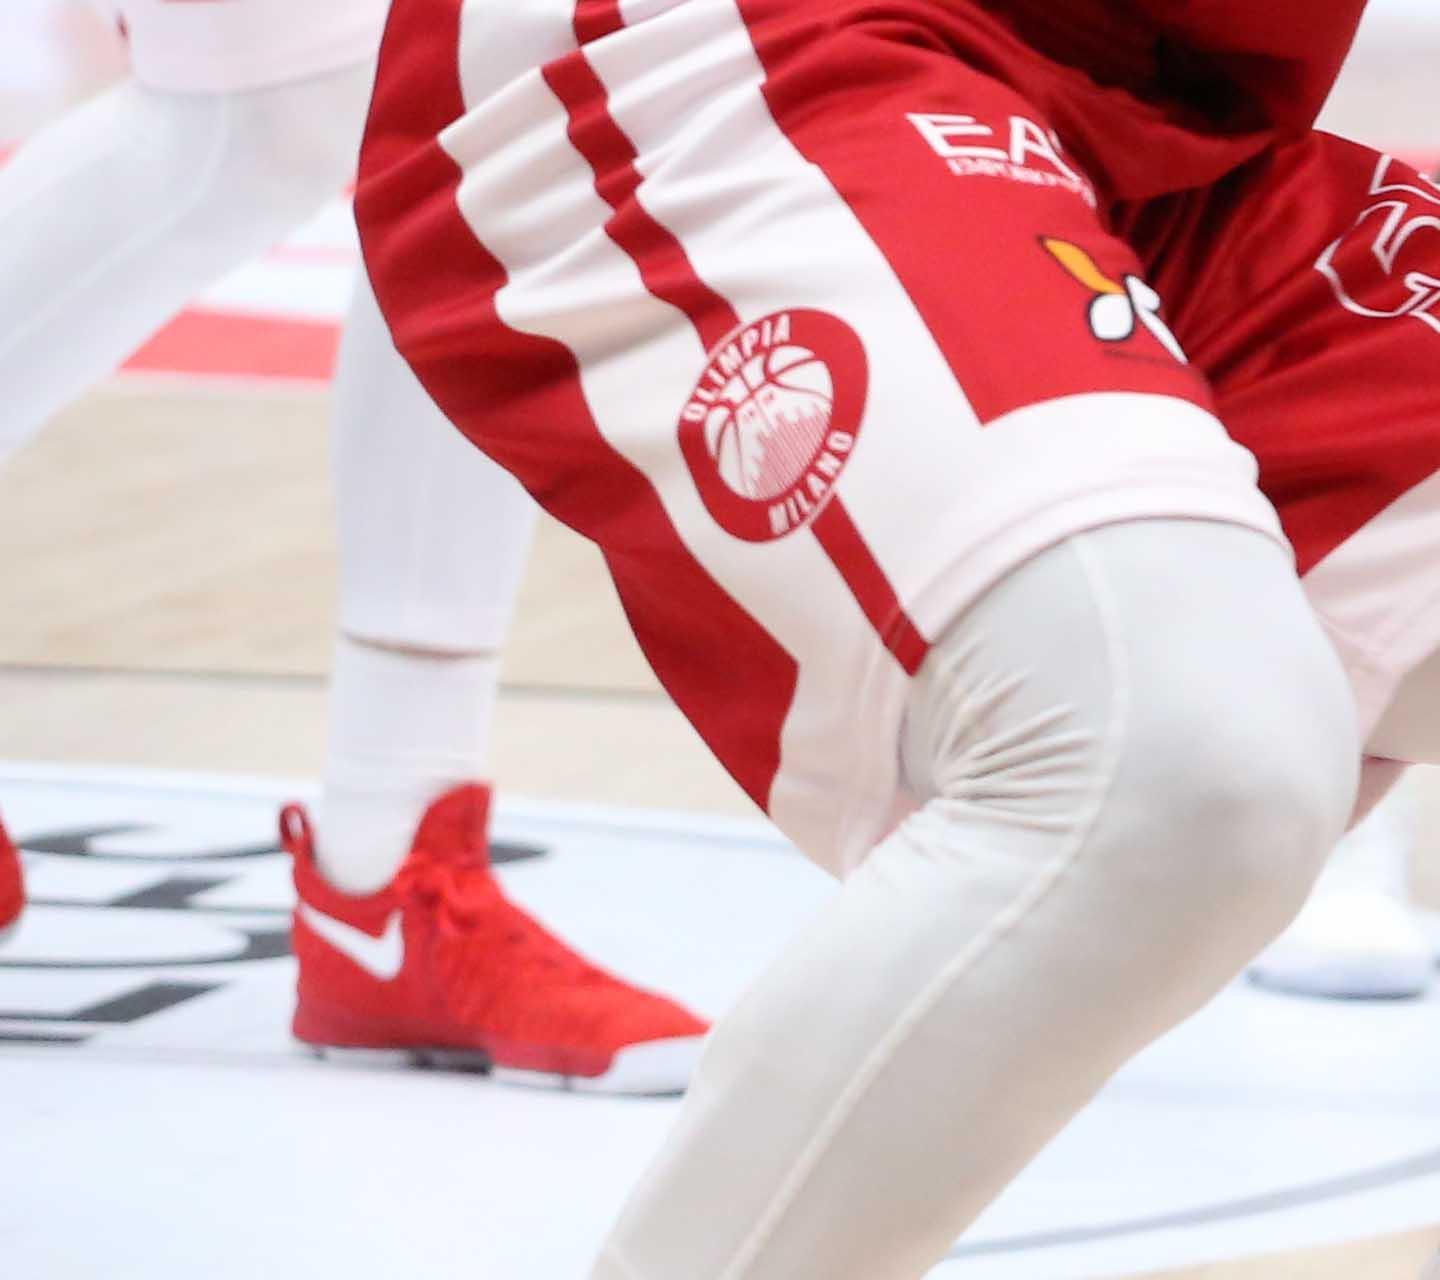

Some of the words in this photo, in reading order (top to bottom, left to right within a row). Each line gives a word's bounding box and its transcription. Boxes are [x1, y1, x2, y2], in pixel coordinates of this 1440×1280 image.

[905, 112, 1082, 184] EA
[682, 312, 791, 423] OLIMPIA
[767, 430, 854, 535] MILANO
